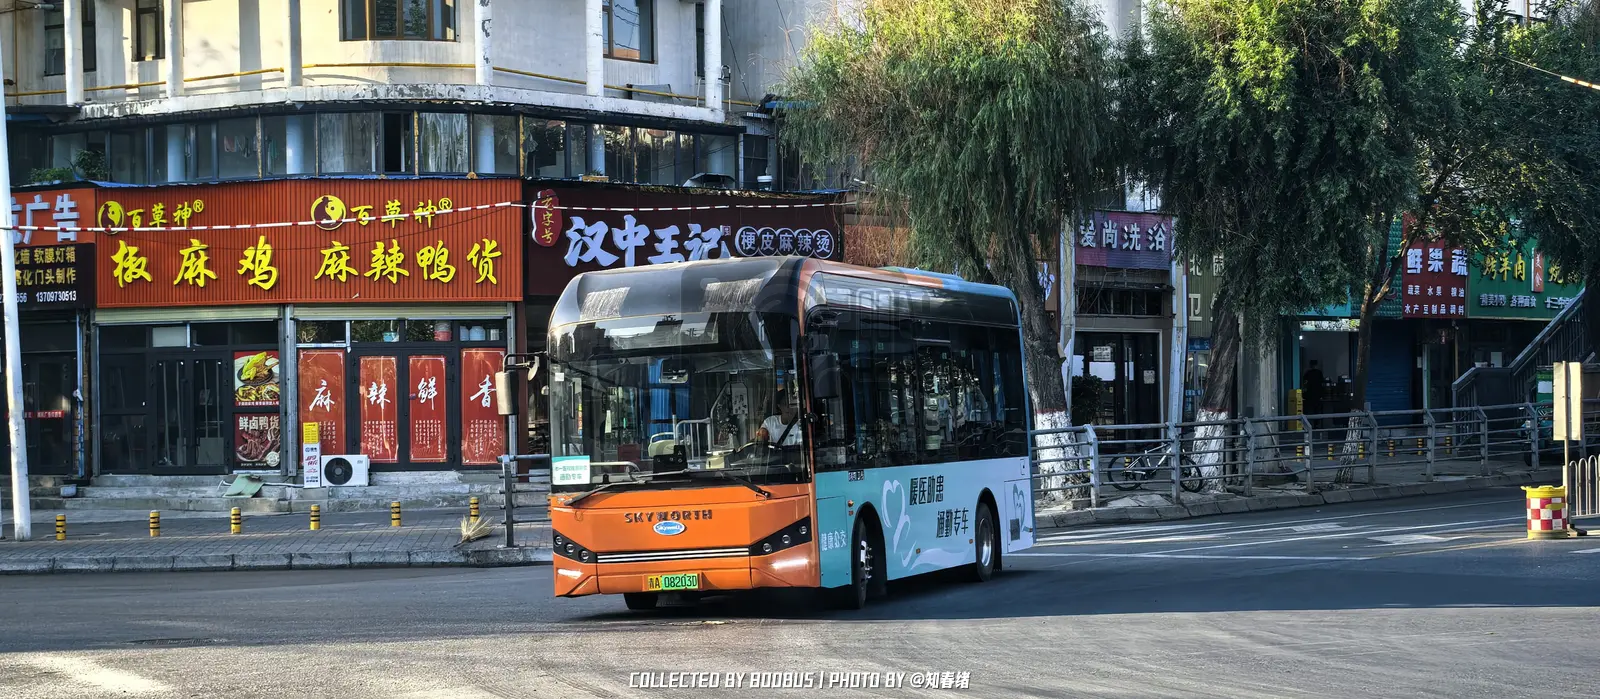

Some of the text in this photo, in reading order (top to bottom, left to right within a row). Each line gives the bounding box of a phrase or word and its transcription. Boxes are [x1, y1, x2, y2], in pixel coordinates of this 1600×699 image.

[563, 214, 731, 267] 汉中王记
[739, 229, 832, 255] 梗皮麻辣烫
[33, 247, 76, 264] 软膜灯箱
[110, 234, 280, 291] 椒麻鸡
[313, 237, 503, 286] 麻辣鸭货
[35, 267, 77, 285] 门头制作
[36, 290, 77, 303] 13709730513
[1427, 285, 1442, 297] 水果
[1404, 303, 1420, 315] 水产
[1423, 303, 1447, 315] 豆制品
[308, 379, 335, 413] 麻
[366, 379, 391, 413] 辣
[469, 374, 497, 408] 香
[238, 415, 280, 432] 鲜卤鸭货
[624, 509, 713, 524] SKYWORTH
[936, 507, 970, 539] 通勤专车
